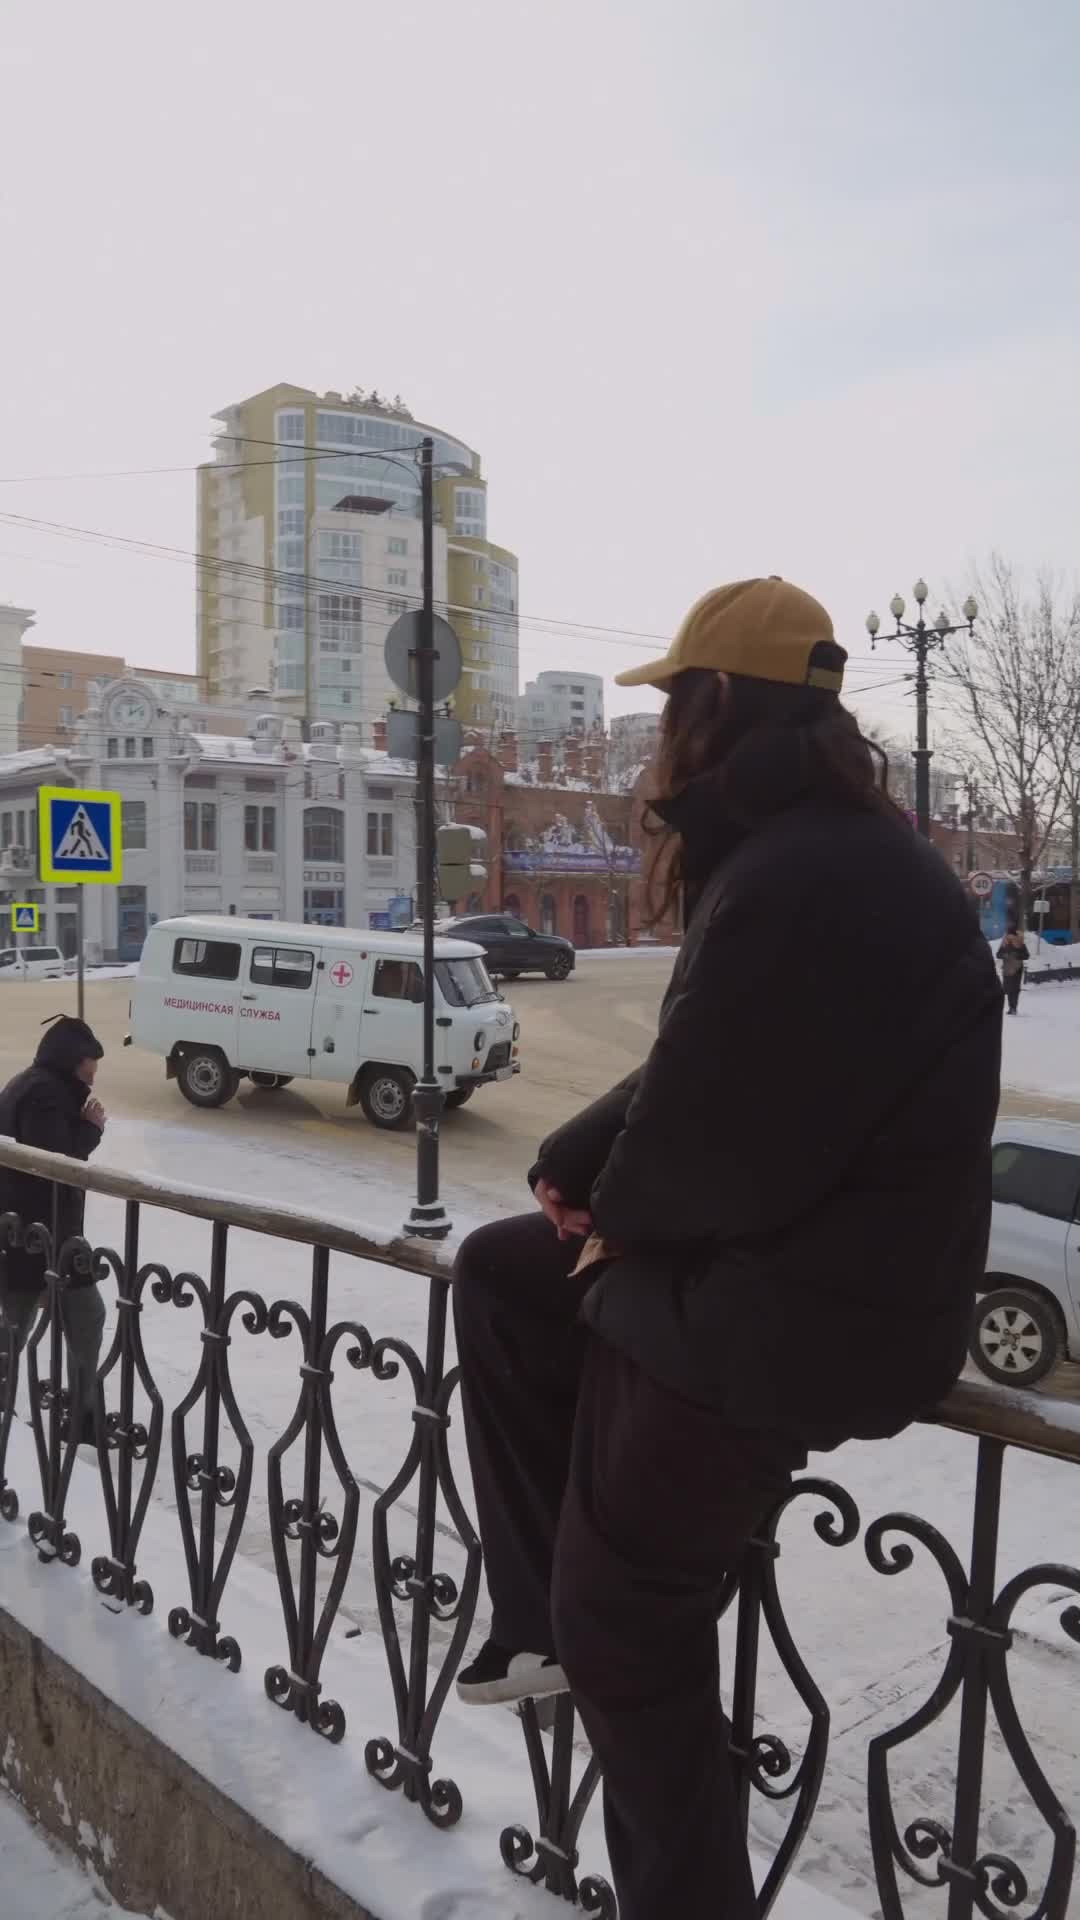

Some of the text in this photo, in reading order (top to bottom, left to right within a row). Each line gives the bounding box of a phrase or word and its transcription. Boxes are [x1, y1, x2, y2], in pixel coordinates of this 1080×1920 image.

[975, 879, 989, 890] 40
[163, 996, 281, 1022] МЕДИЦИНСКАЯ СЛУЖБА
